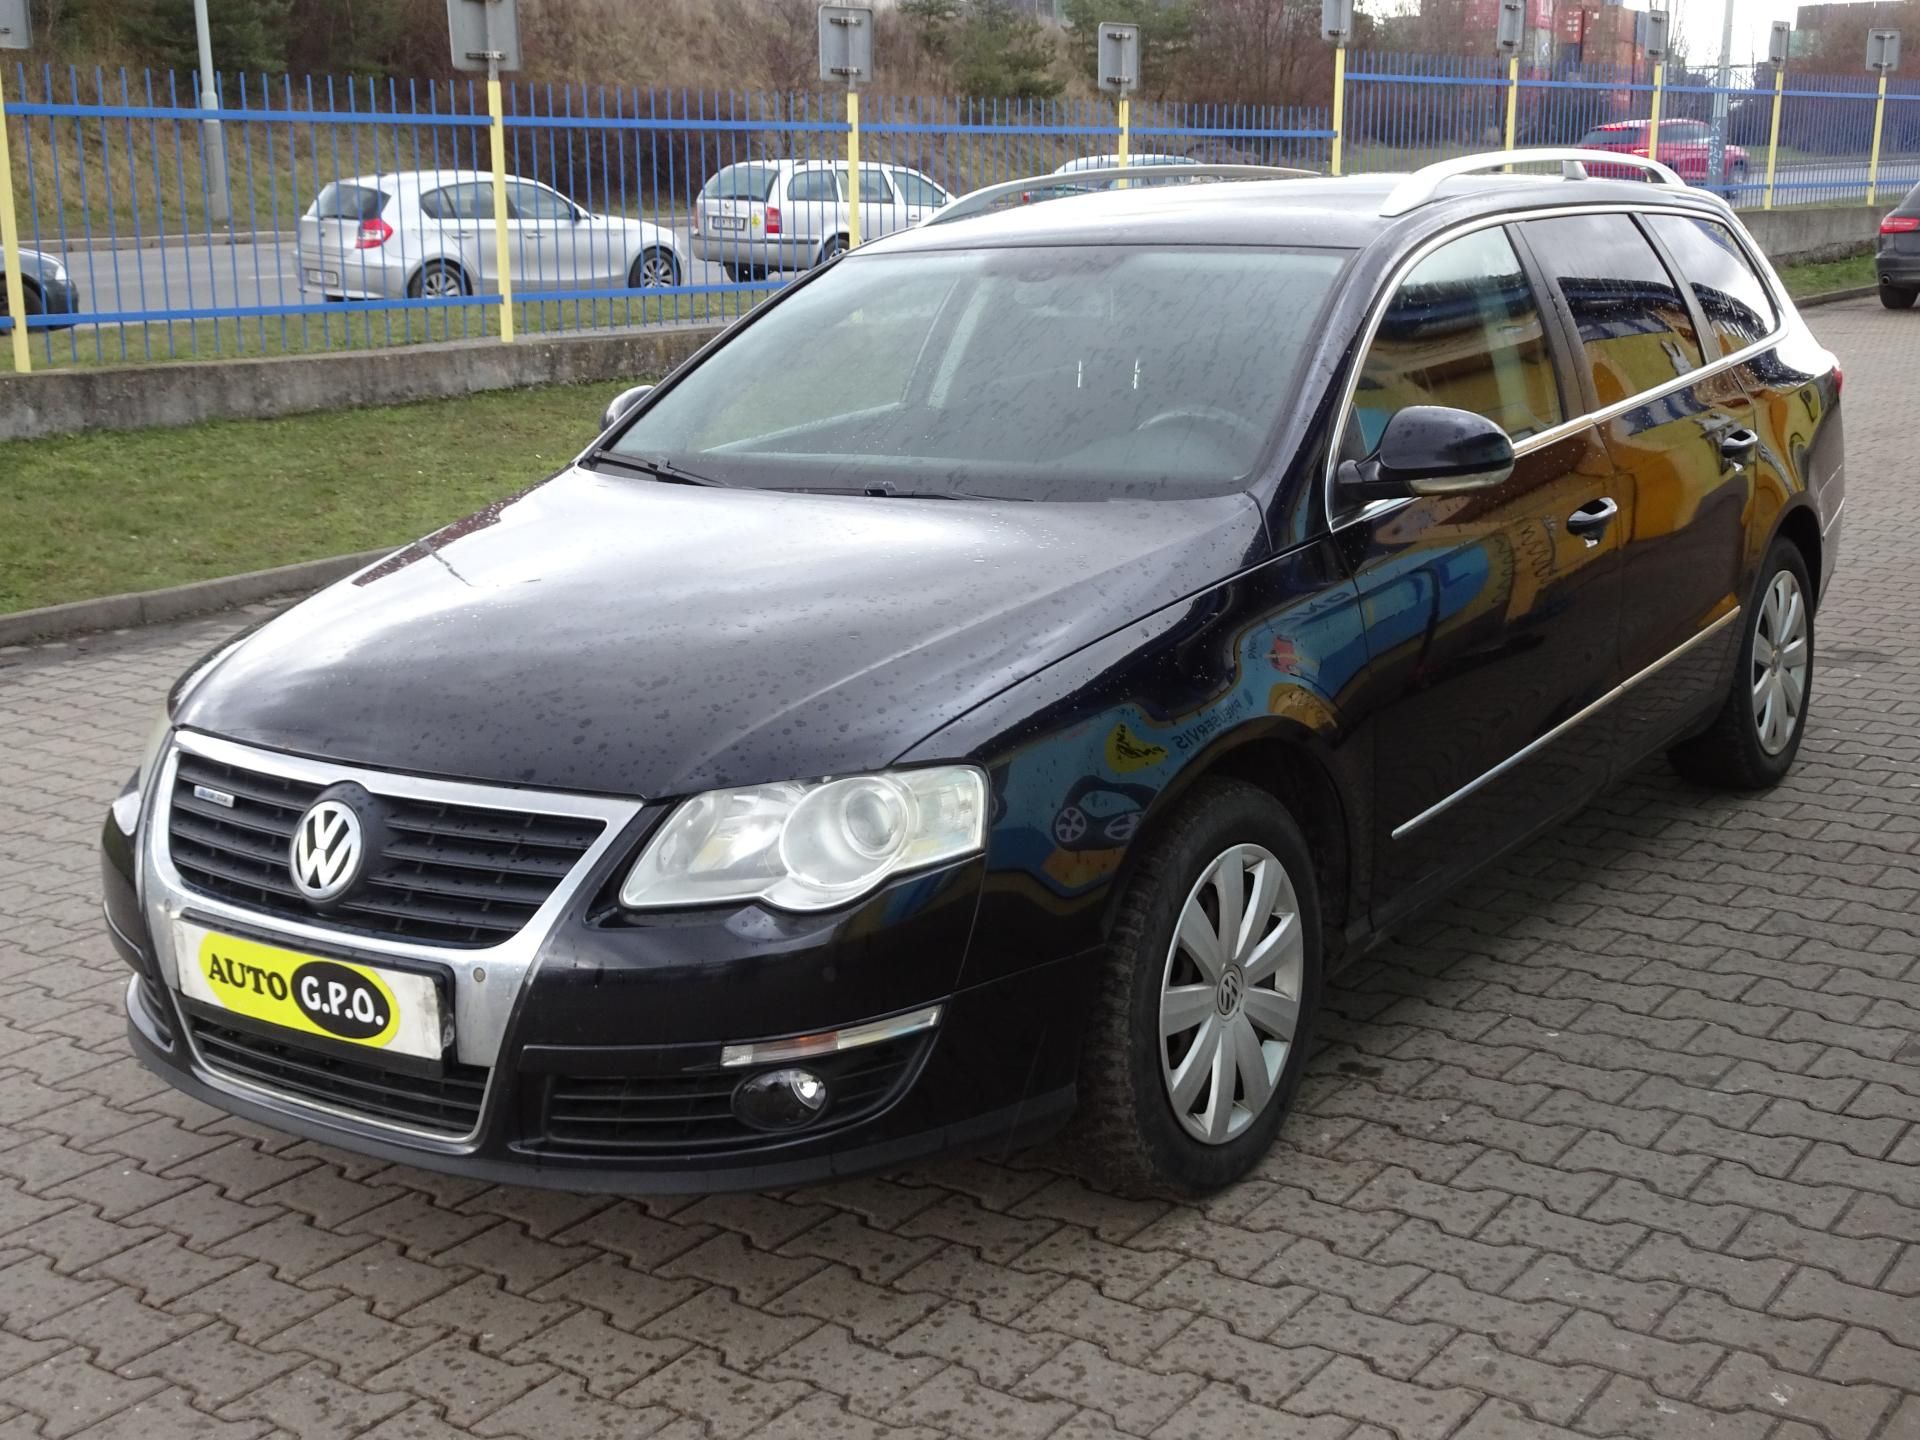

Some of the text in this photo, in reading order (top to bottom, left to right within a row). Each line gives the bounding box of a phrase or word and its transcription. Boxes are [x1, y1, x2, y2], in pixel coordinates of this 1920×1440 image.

[294, 805, 357, 894] VW
[208, 952, 385, 1027] AUTO G.P.O.
